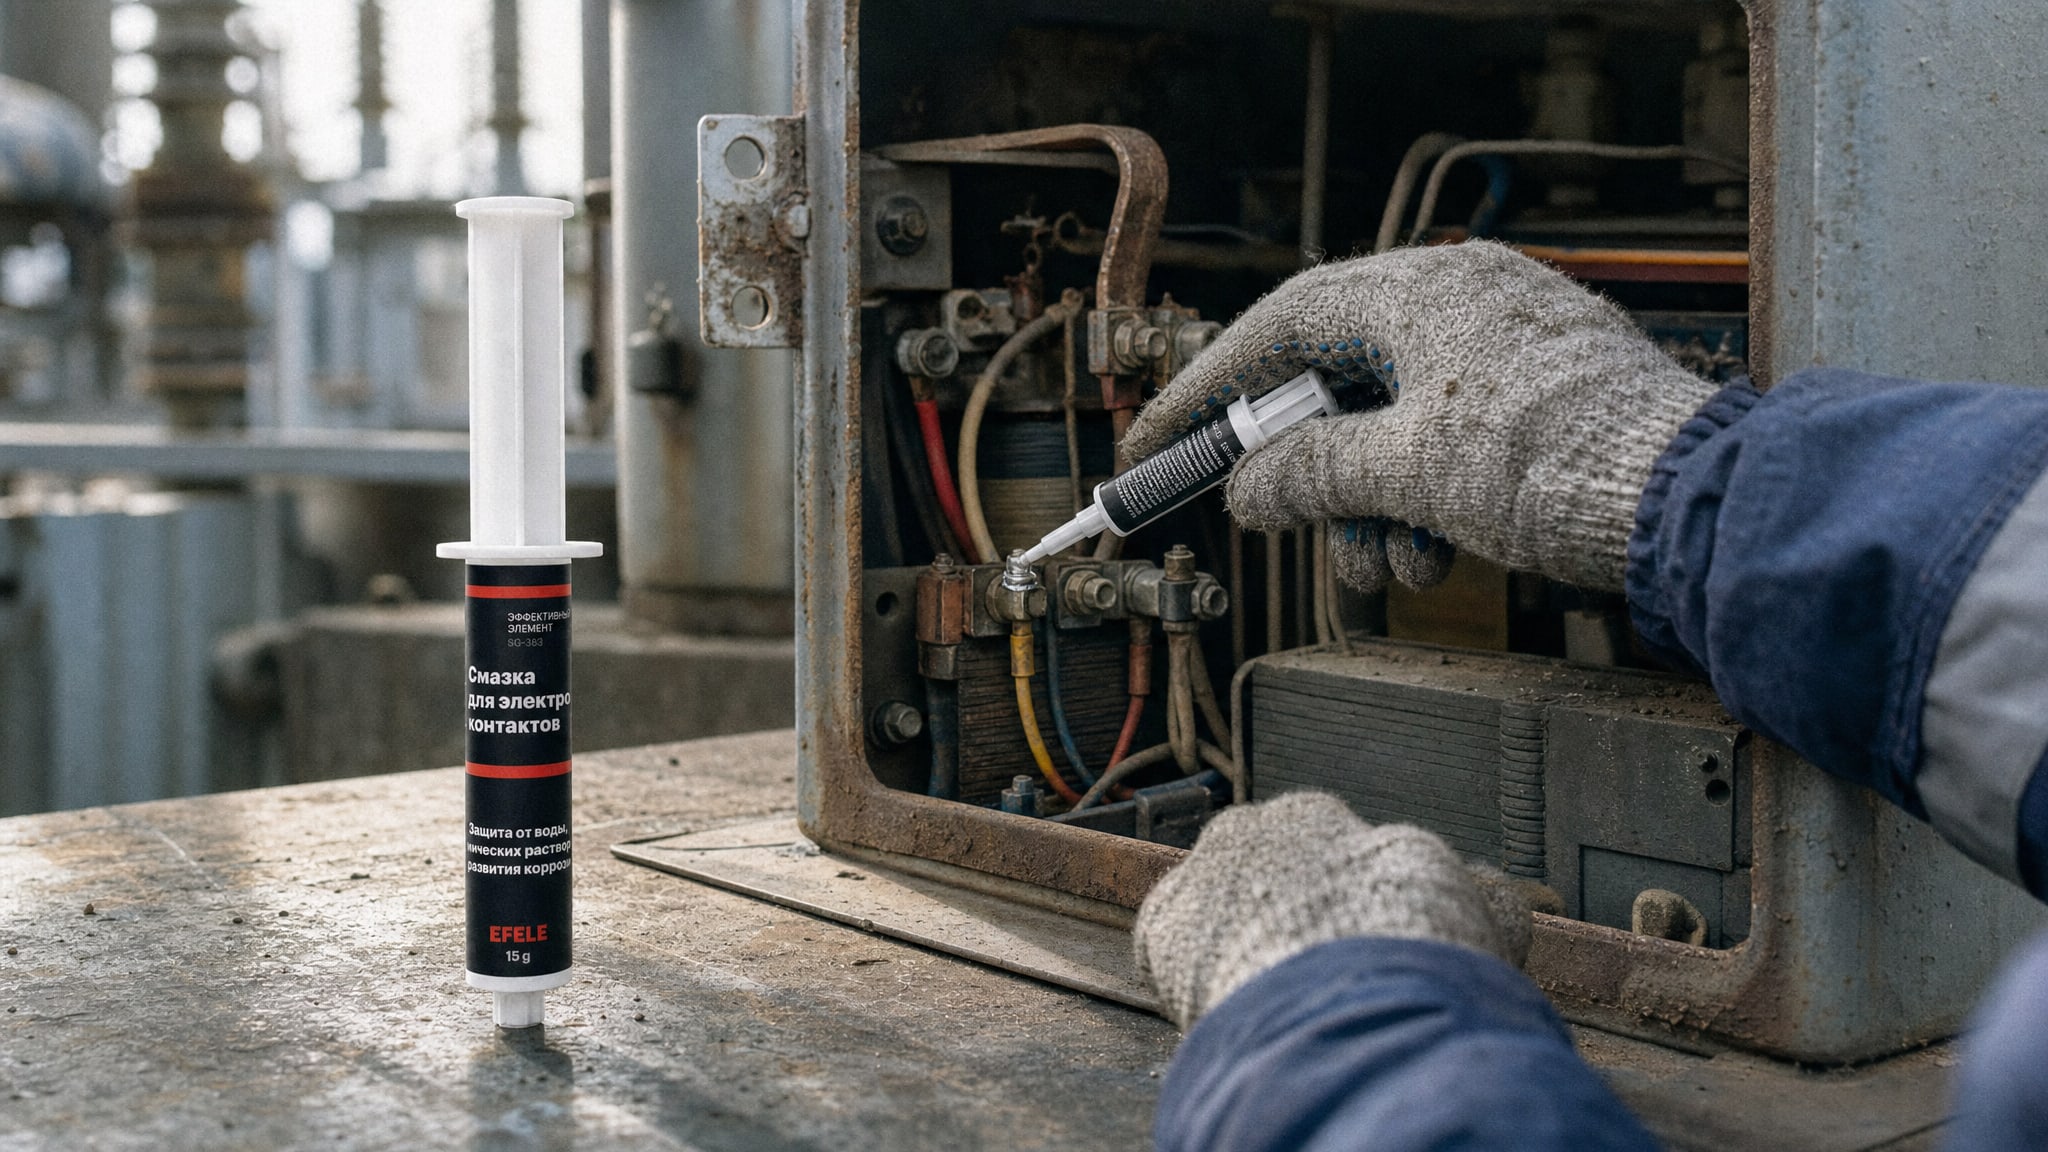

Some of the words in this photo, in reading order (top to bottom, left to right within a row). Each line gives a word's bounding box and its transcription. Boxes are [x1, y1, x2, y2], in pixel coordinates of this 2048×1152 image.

[507, 623, 553, 633] ЭЛЕМЕНТ
[468, 665, 536, 685] Смазка
[468, 693, 495, 710] для
[498, 692, 571, 711] электро
[468, 717, 561, 734] контактов
[468, 822, 513, 839] Защита
[515, 828, 532, 839] от
[534, 824, 568, 838] воды,
[525, 840, 571, 859] раствор
[467, 861, 521, 875] развития
[489, 923, 548, 943] EFELE
[505, 950, 520, 962] 15
[522, 952, 531, 964] g
